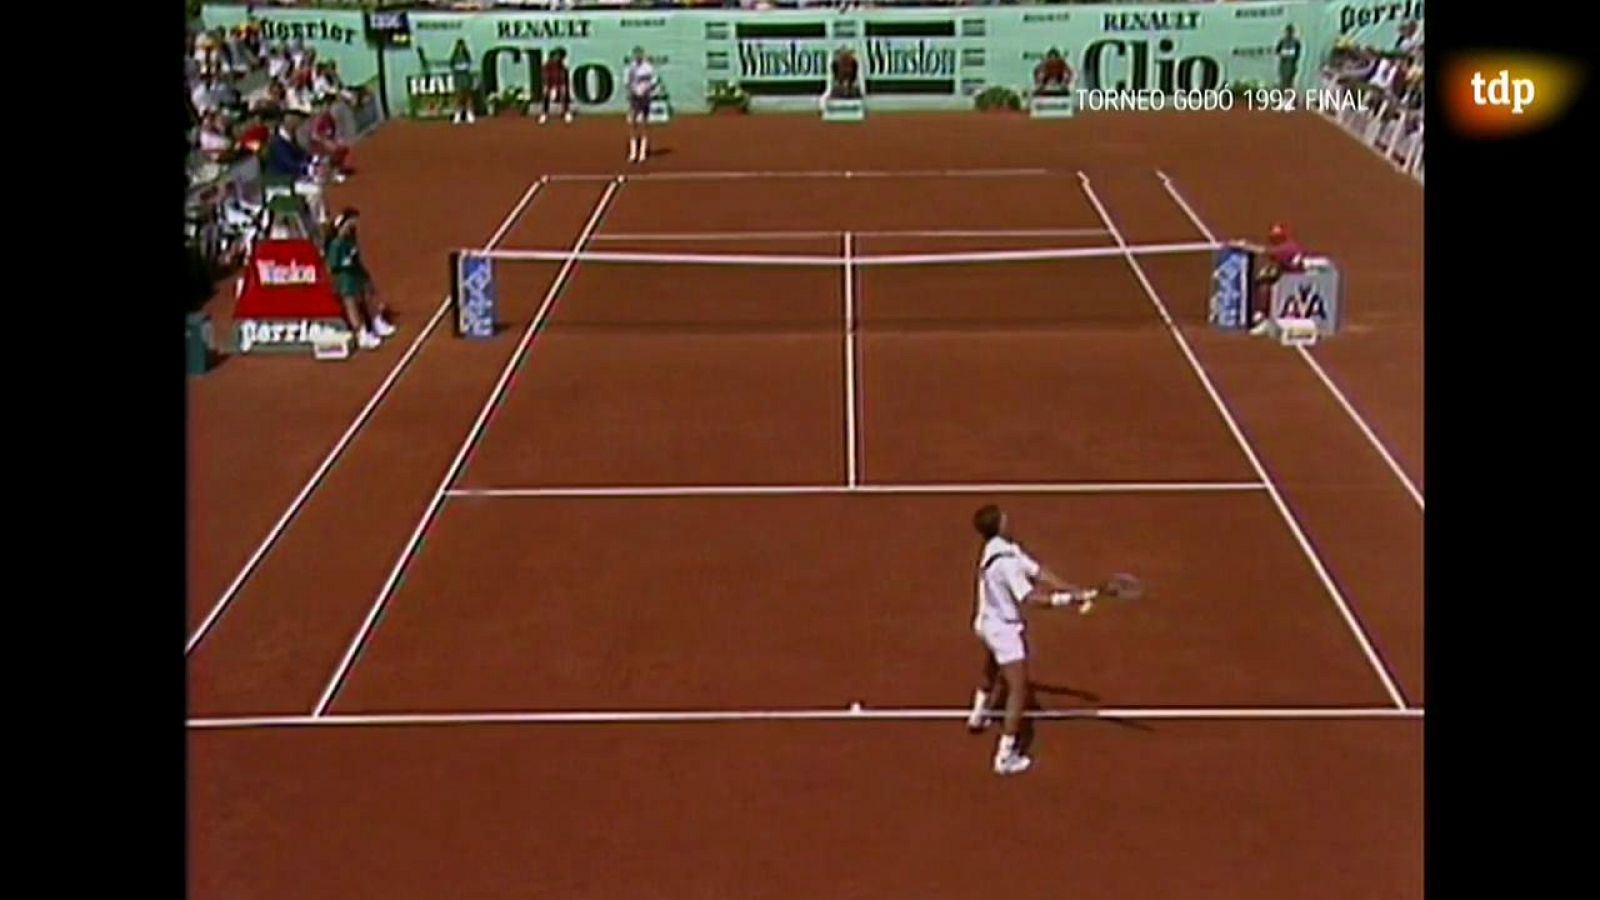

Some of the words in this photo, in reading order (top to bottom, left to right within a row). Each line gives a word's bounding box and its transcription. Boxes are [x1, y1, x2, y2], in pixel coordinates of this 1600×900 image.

[498, 20, 590, 38] RENAULT
[1103, 11, 1200, 31] RENAULT
[738, 40, 826, 76] Winston
[866, 39, 955, 75] Winston
[1084, 38, 1220, 97] Clio
[481, 47, 614, 104] Clo
